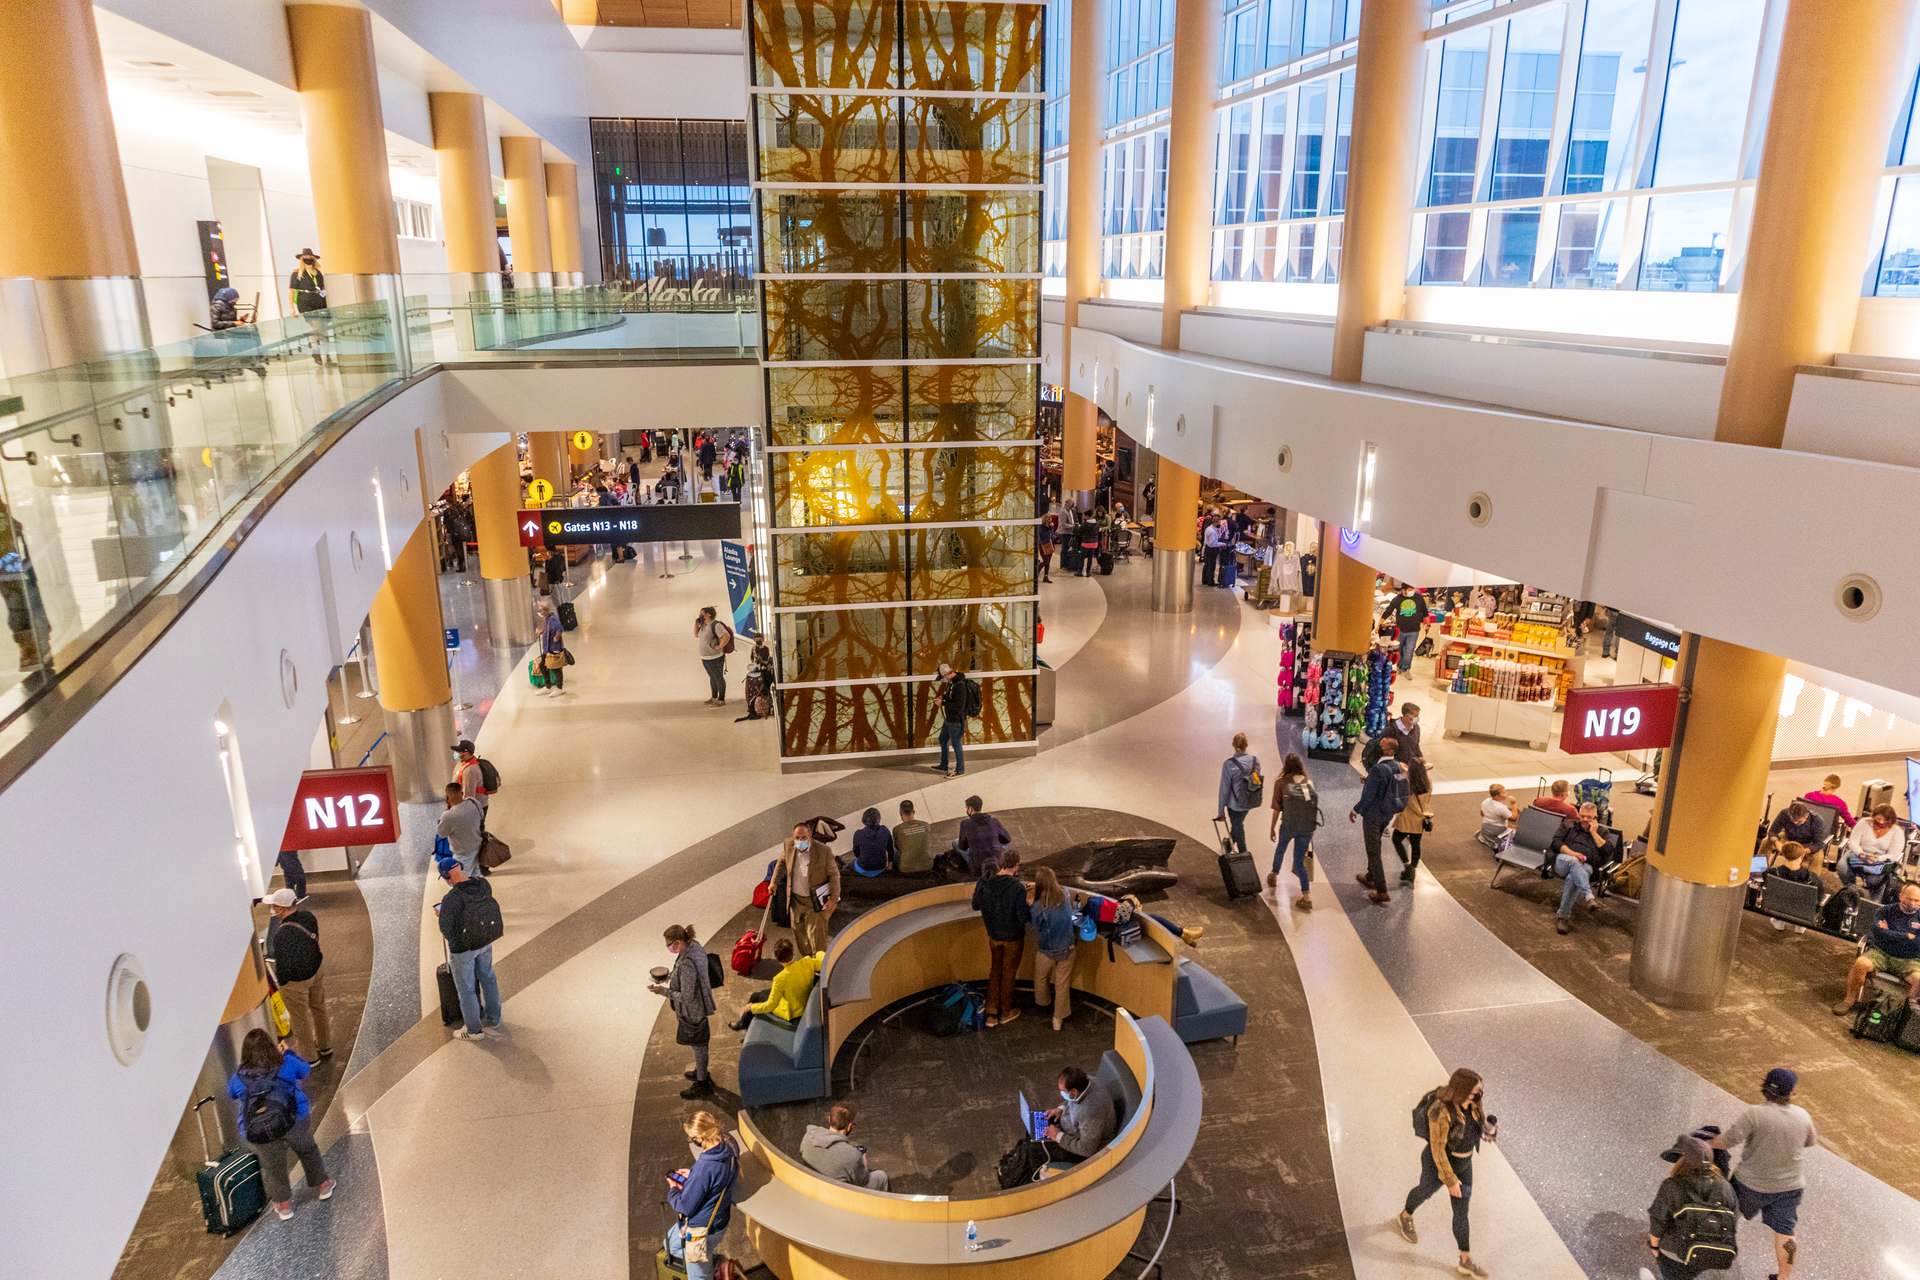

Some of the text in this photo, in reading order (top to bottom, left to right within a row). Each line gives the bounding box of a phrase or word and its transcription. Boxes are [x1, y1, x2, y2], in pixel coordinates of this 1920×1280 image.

[621, 276, 721, 302] Alaska
[564, 522, 591, 532] Gates
[592, 521, 611, 531] N13
[619, 520, 638, 530] N18
[725, 553, 741, 564] Lounge
[1644, 631, 1680, 653] Baggage Clai
[1584, 706, 1641, 738] N19
[305, 793, 384, 830] N12
